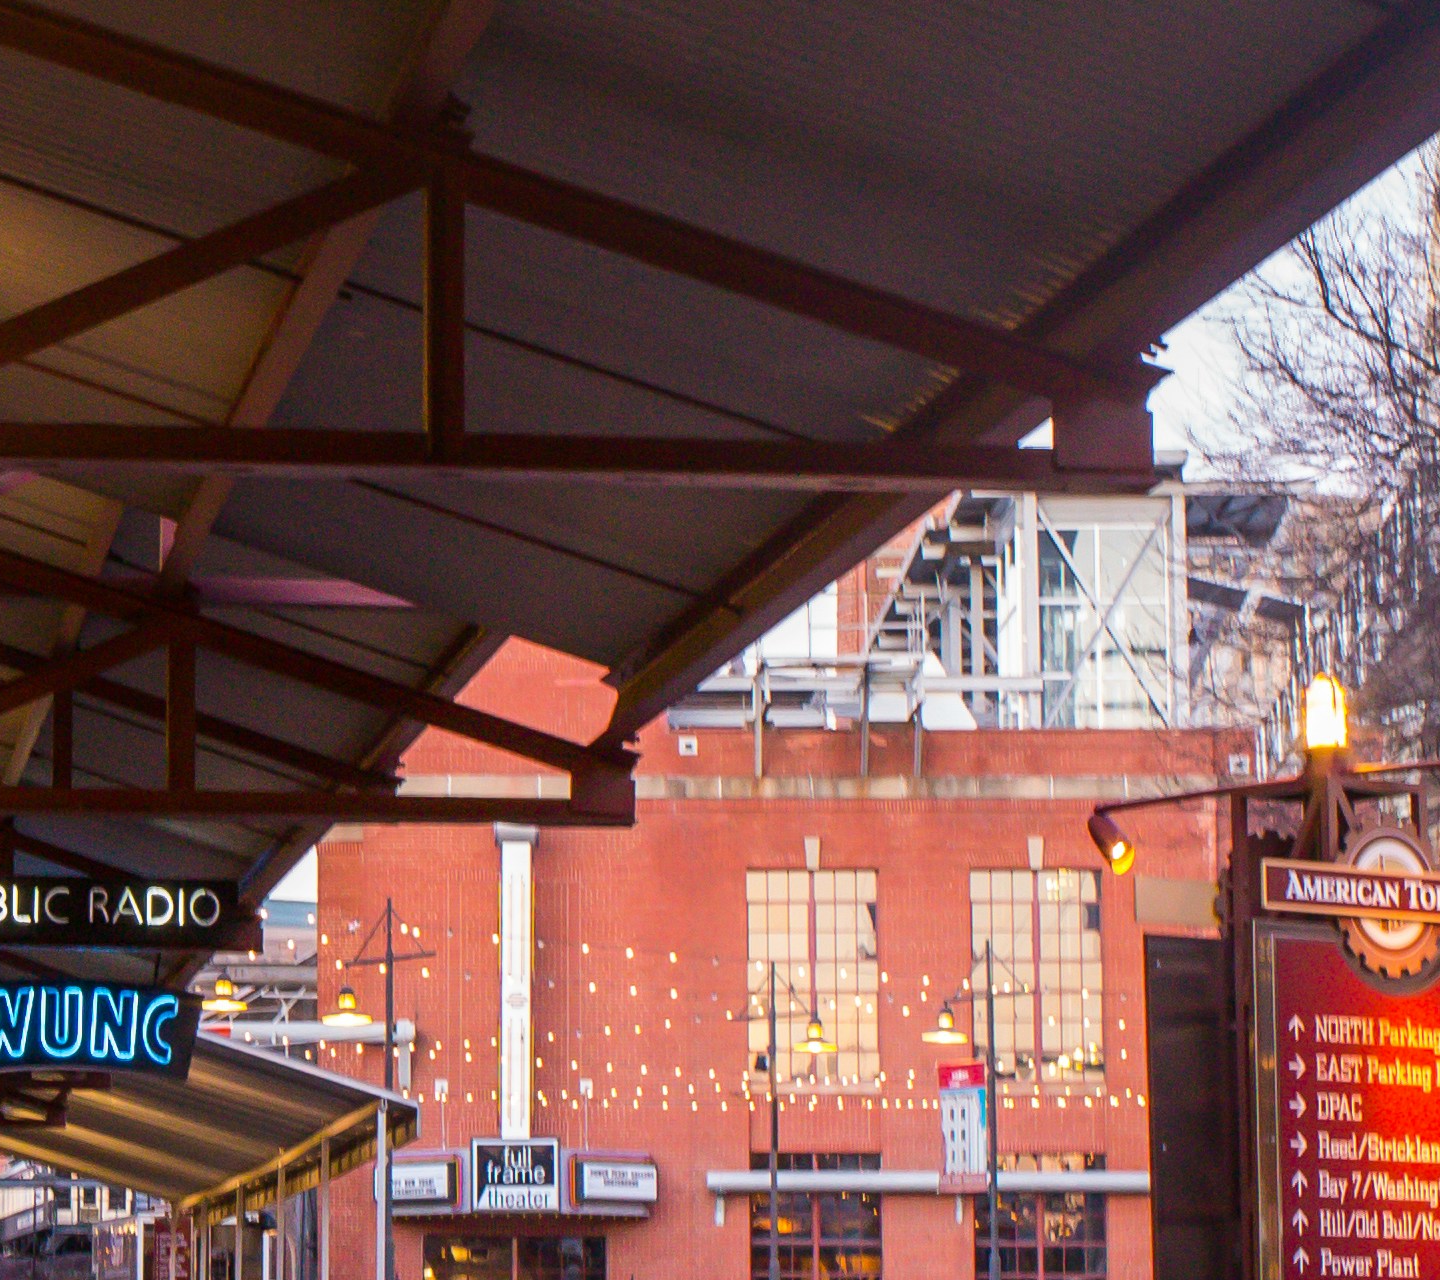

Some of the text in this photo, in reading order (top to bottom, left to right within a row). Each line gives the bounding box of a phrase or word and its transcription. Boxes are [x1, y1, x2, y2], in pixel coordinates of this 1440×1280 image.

[1285, 869, 1401, 908] AMERICAN
[89, 885, 221, 928] RADIO
[1315, 1014, 1375, 1046] NORTH
[1315, 1052, 1364, 1084] EAST
[1366, 1054, 1432, 1094] Parking
[1316, 1091, 1363, 1123] DPAC
[487, 1160, 546, 1184] frame
[504, 1145, 532, 1169] full
[487, 1185, 549, 1209] theater
[1318, 1169, 1348, 1206] Bay
[1319, 1208, 1380, 1239] Hill/Old
[1320, 1247, 1420, 1279] Power Plant
